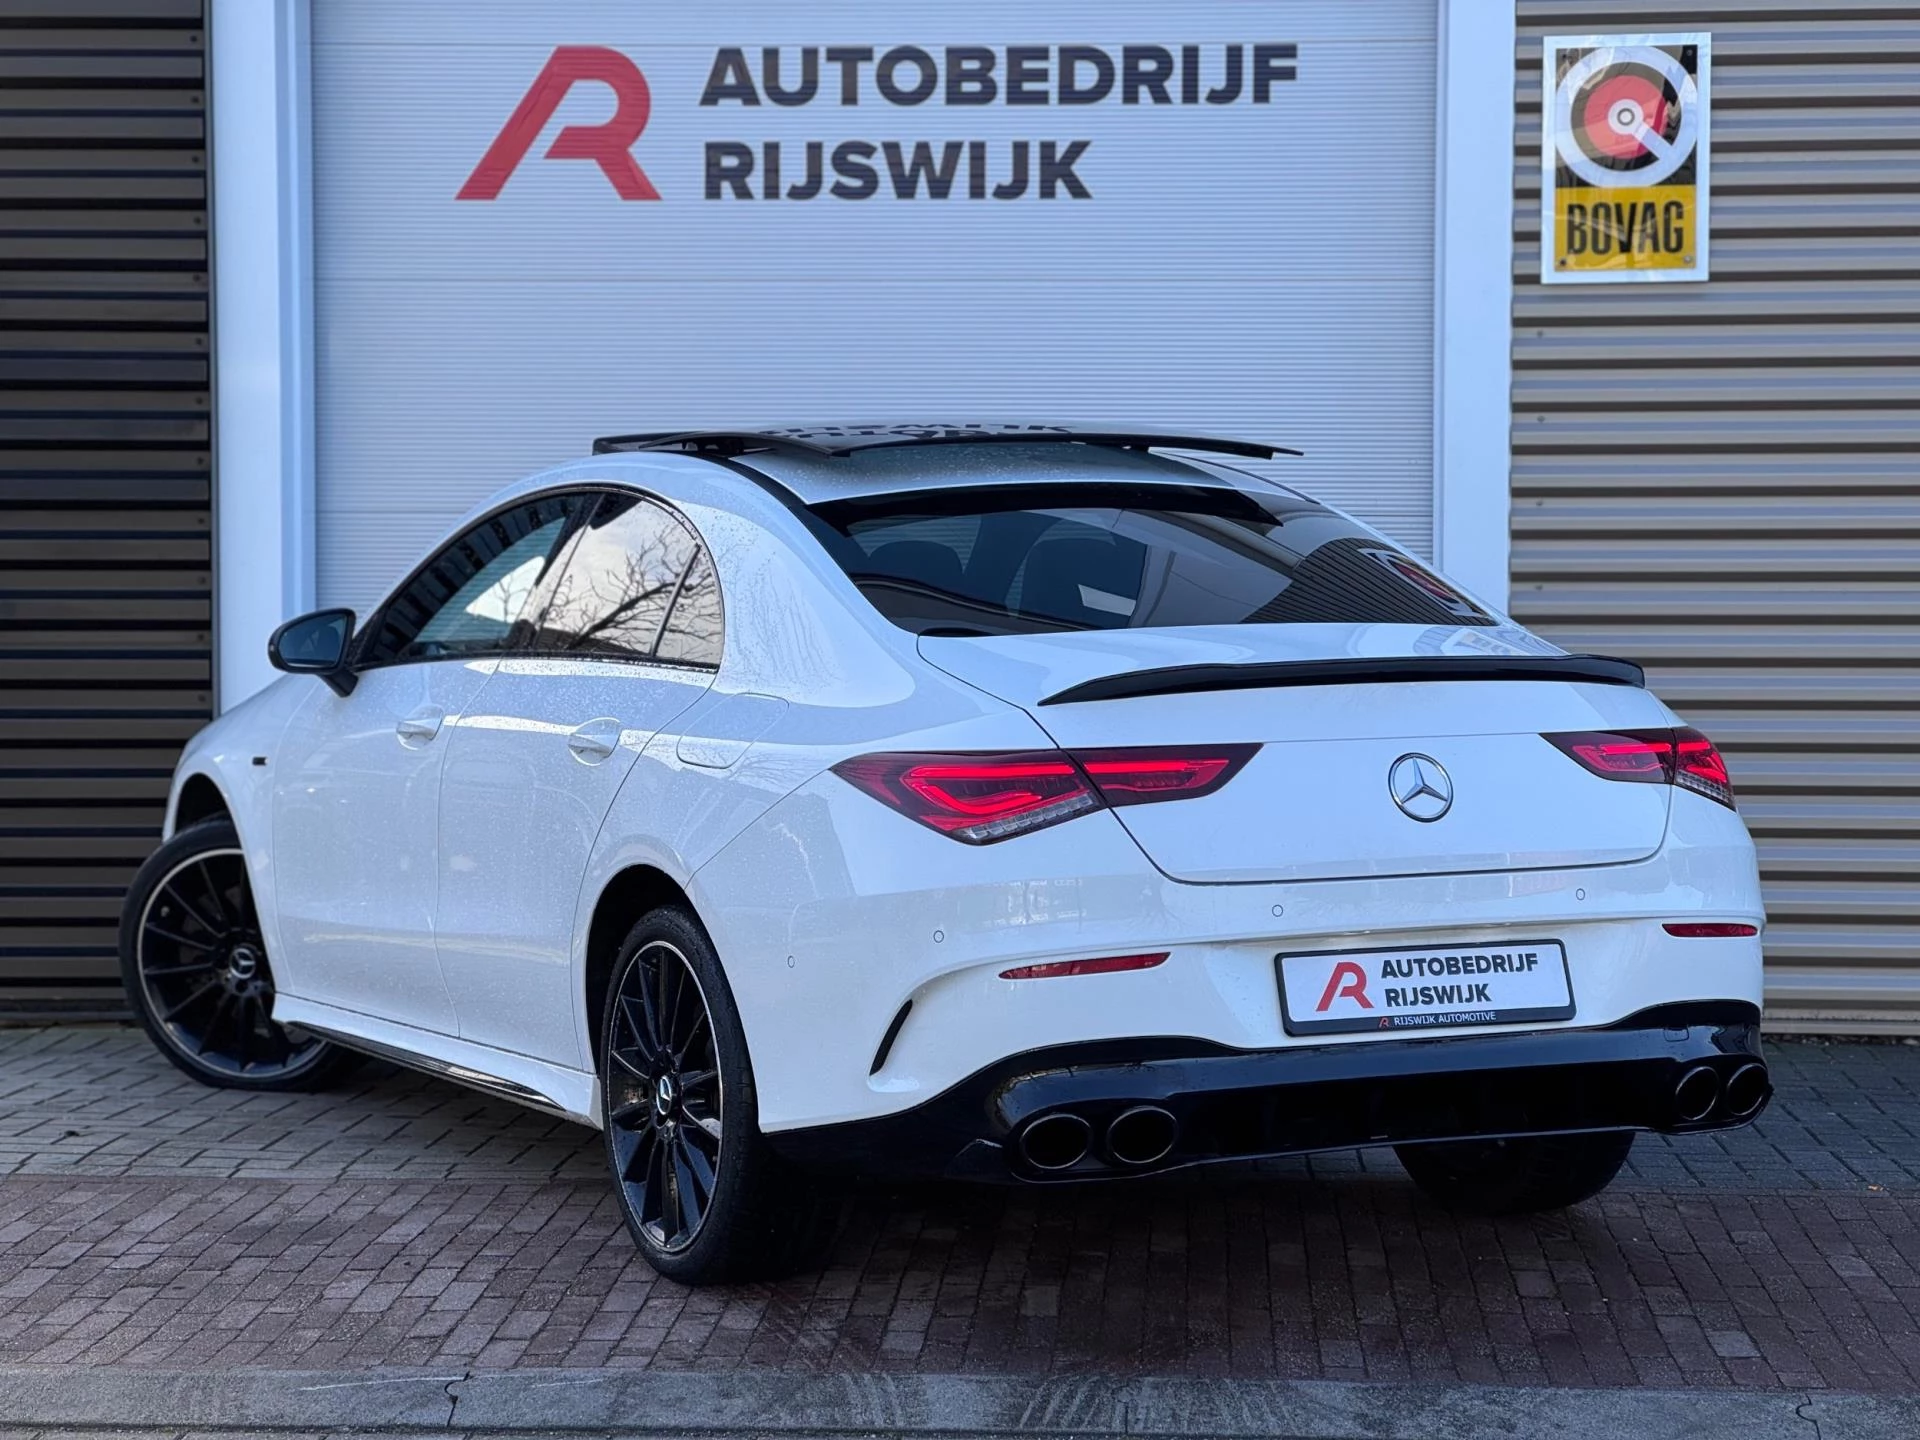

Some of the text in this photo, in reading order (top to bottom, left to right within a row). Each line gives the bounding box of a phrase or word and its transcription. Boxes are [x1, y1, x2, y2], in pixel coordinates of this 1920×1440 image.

[699, 44, 1298, 107] AUTOBEDRIJF
[704, 140, 1093, 201] RIJSWIJK
[1567, 200, 1684, 255] BOVAG
[1381, 953, 1538, 979] AUTOBEDRIJF
[1384, 983, 1493, 1008] RIJSWIJK
[1394, 1014, 1436, 1026] RIJSWIJK
[1438, 1011, 1497, 1025] AUTOMOTIVE
